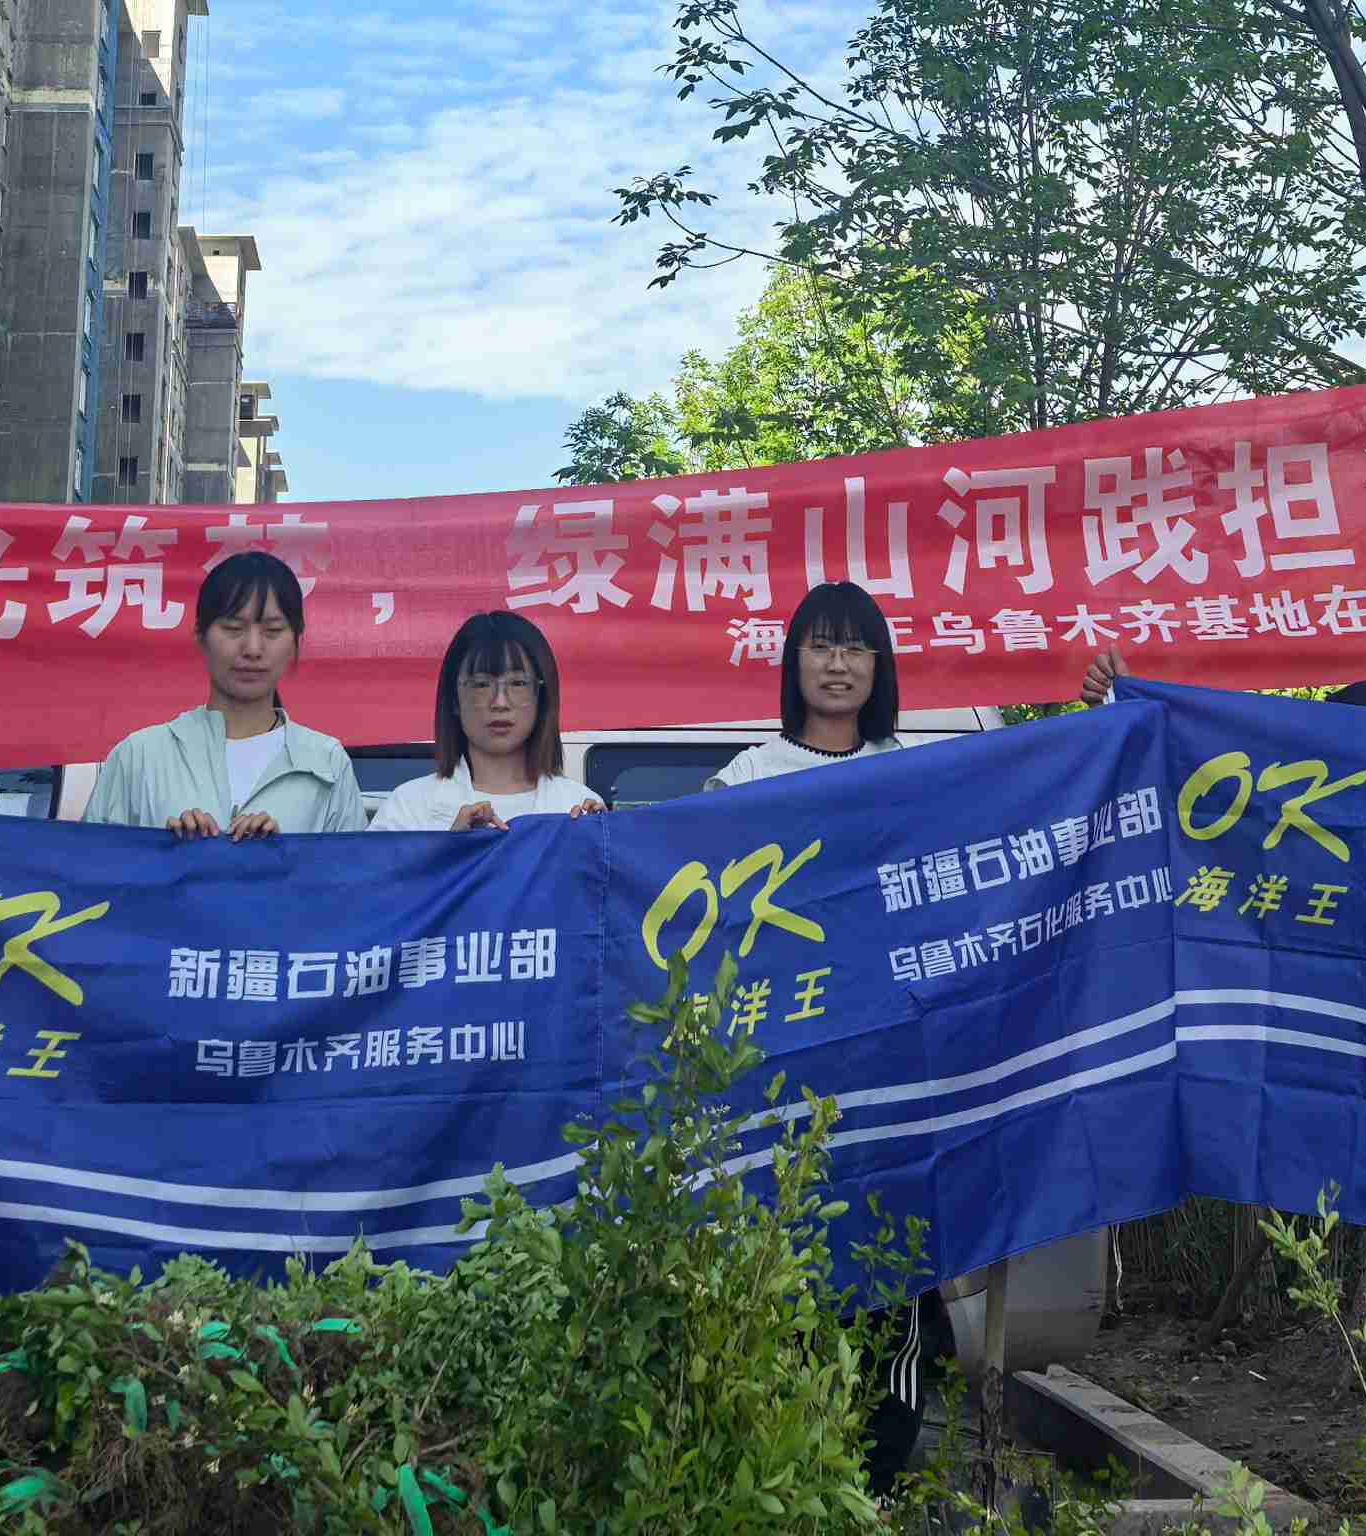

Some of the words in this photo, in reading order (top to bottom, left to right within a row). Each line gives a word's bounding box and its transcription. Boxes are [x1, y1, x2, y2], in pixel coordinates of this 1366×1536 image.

[877, 786, 1164, 913] 新疆石油事业部
[1176, 865, 1350, 928] 海洋王
[642, 839, 826, 971] OK
[888, 865, 1175, 982] 乌鲁木齐石化服务中心
[167, 927, 558, 1004] 新疆石油事业部
[195, 1020, 526, 1078] 乌鲁木齐服务中心
